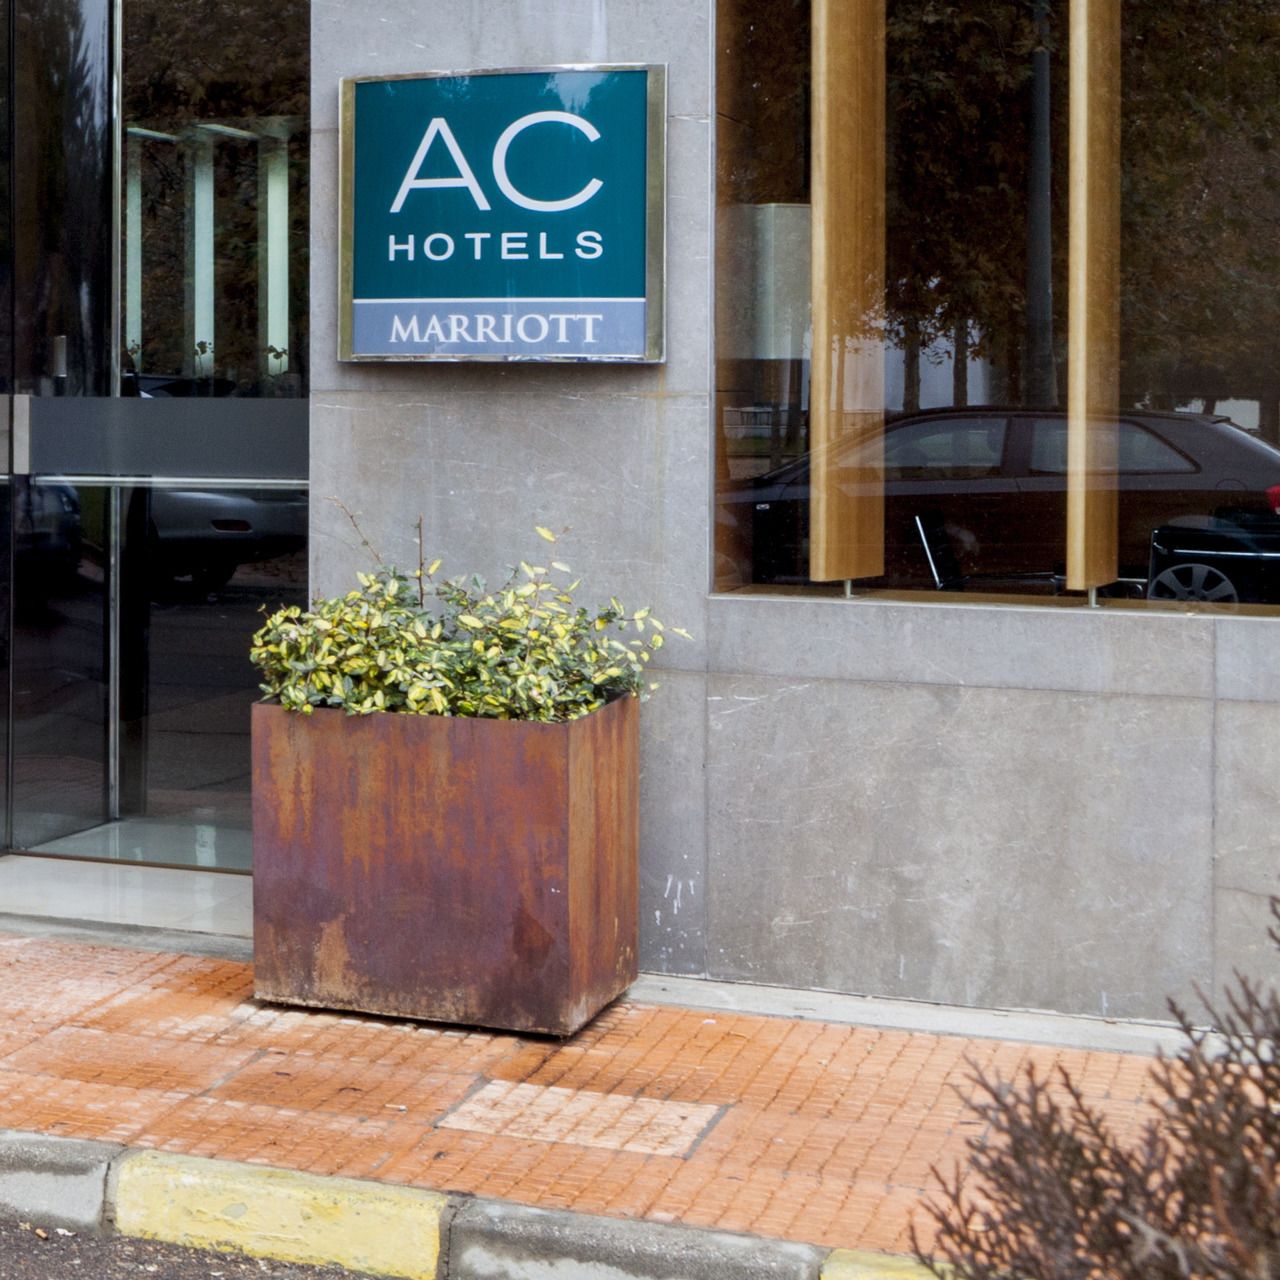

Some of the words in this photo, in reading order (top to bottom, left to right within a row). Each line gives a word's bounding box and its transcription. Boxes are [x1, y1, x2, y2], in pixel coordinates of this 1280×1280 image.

[389, 111, 604, 212] AC
[389, 231, 604, 261] HOTELS
[390, 314, 603, 343] MARRIOTT
